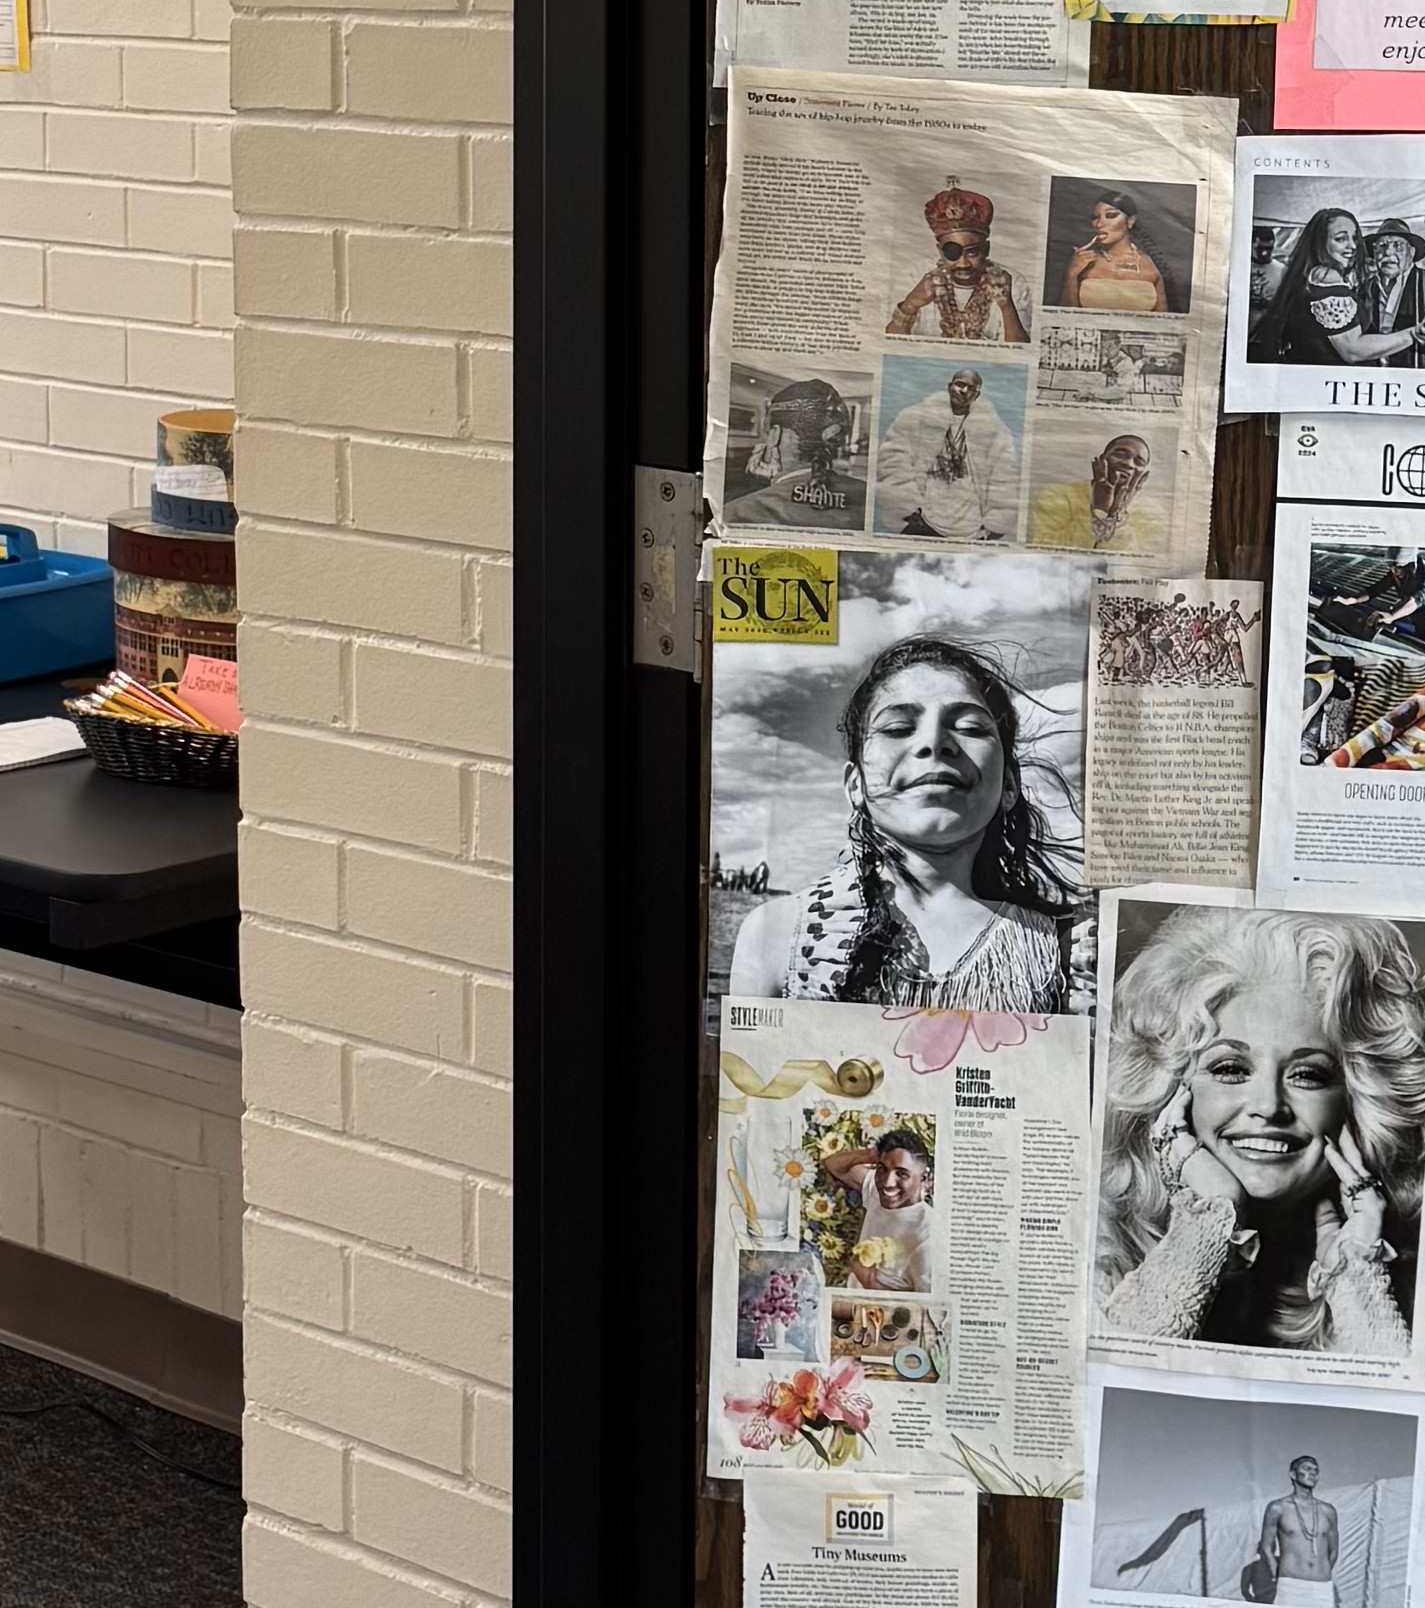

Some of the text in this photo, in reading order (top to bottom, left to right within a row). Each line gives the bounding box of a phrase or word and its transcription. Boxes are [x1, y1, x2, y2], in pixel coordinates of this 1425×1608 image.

[748, 93, 797, 105] Up Close
[1254, 156, 1331, 169] CONTENTS
[1325, 380, 1403, 408] THE
[718, 557, 760, 576] The
[720, 577, 835, 623] SUN
[1345, 782, 1395, 802] OPENING
[835, 1509, 884, 1532] GOOD
[812, 1546, 907, 1563] Tiny Museums
